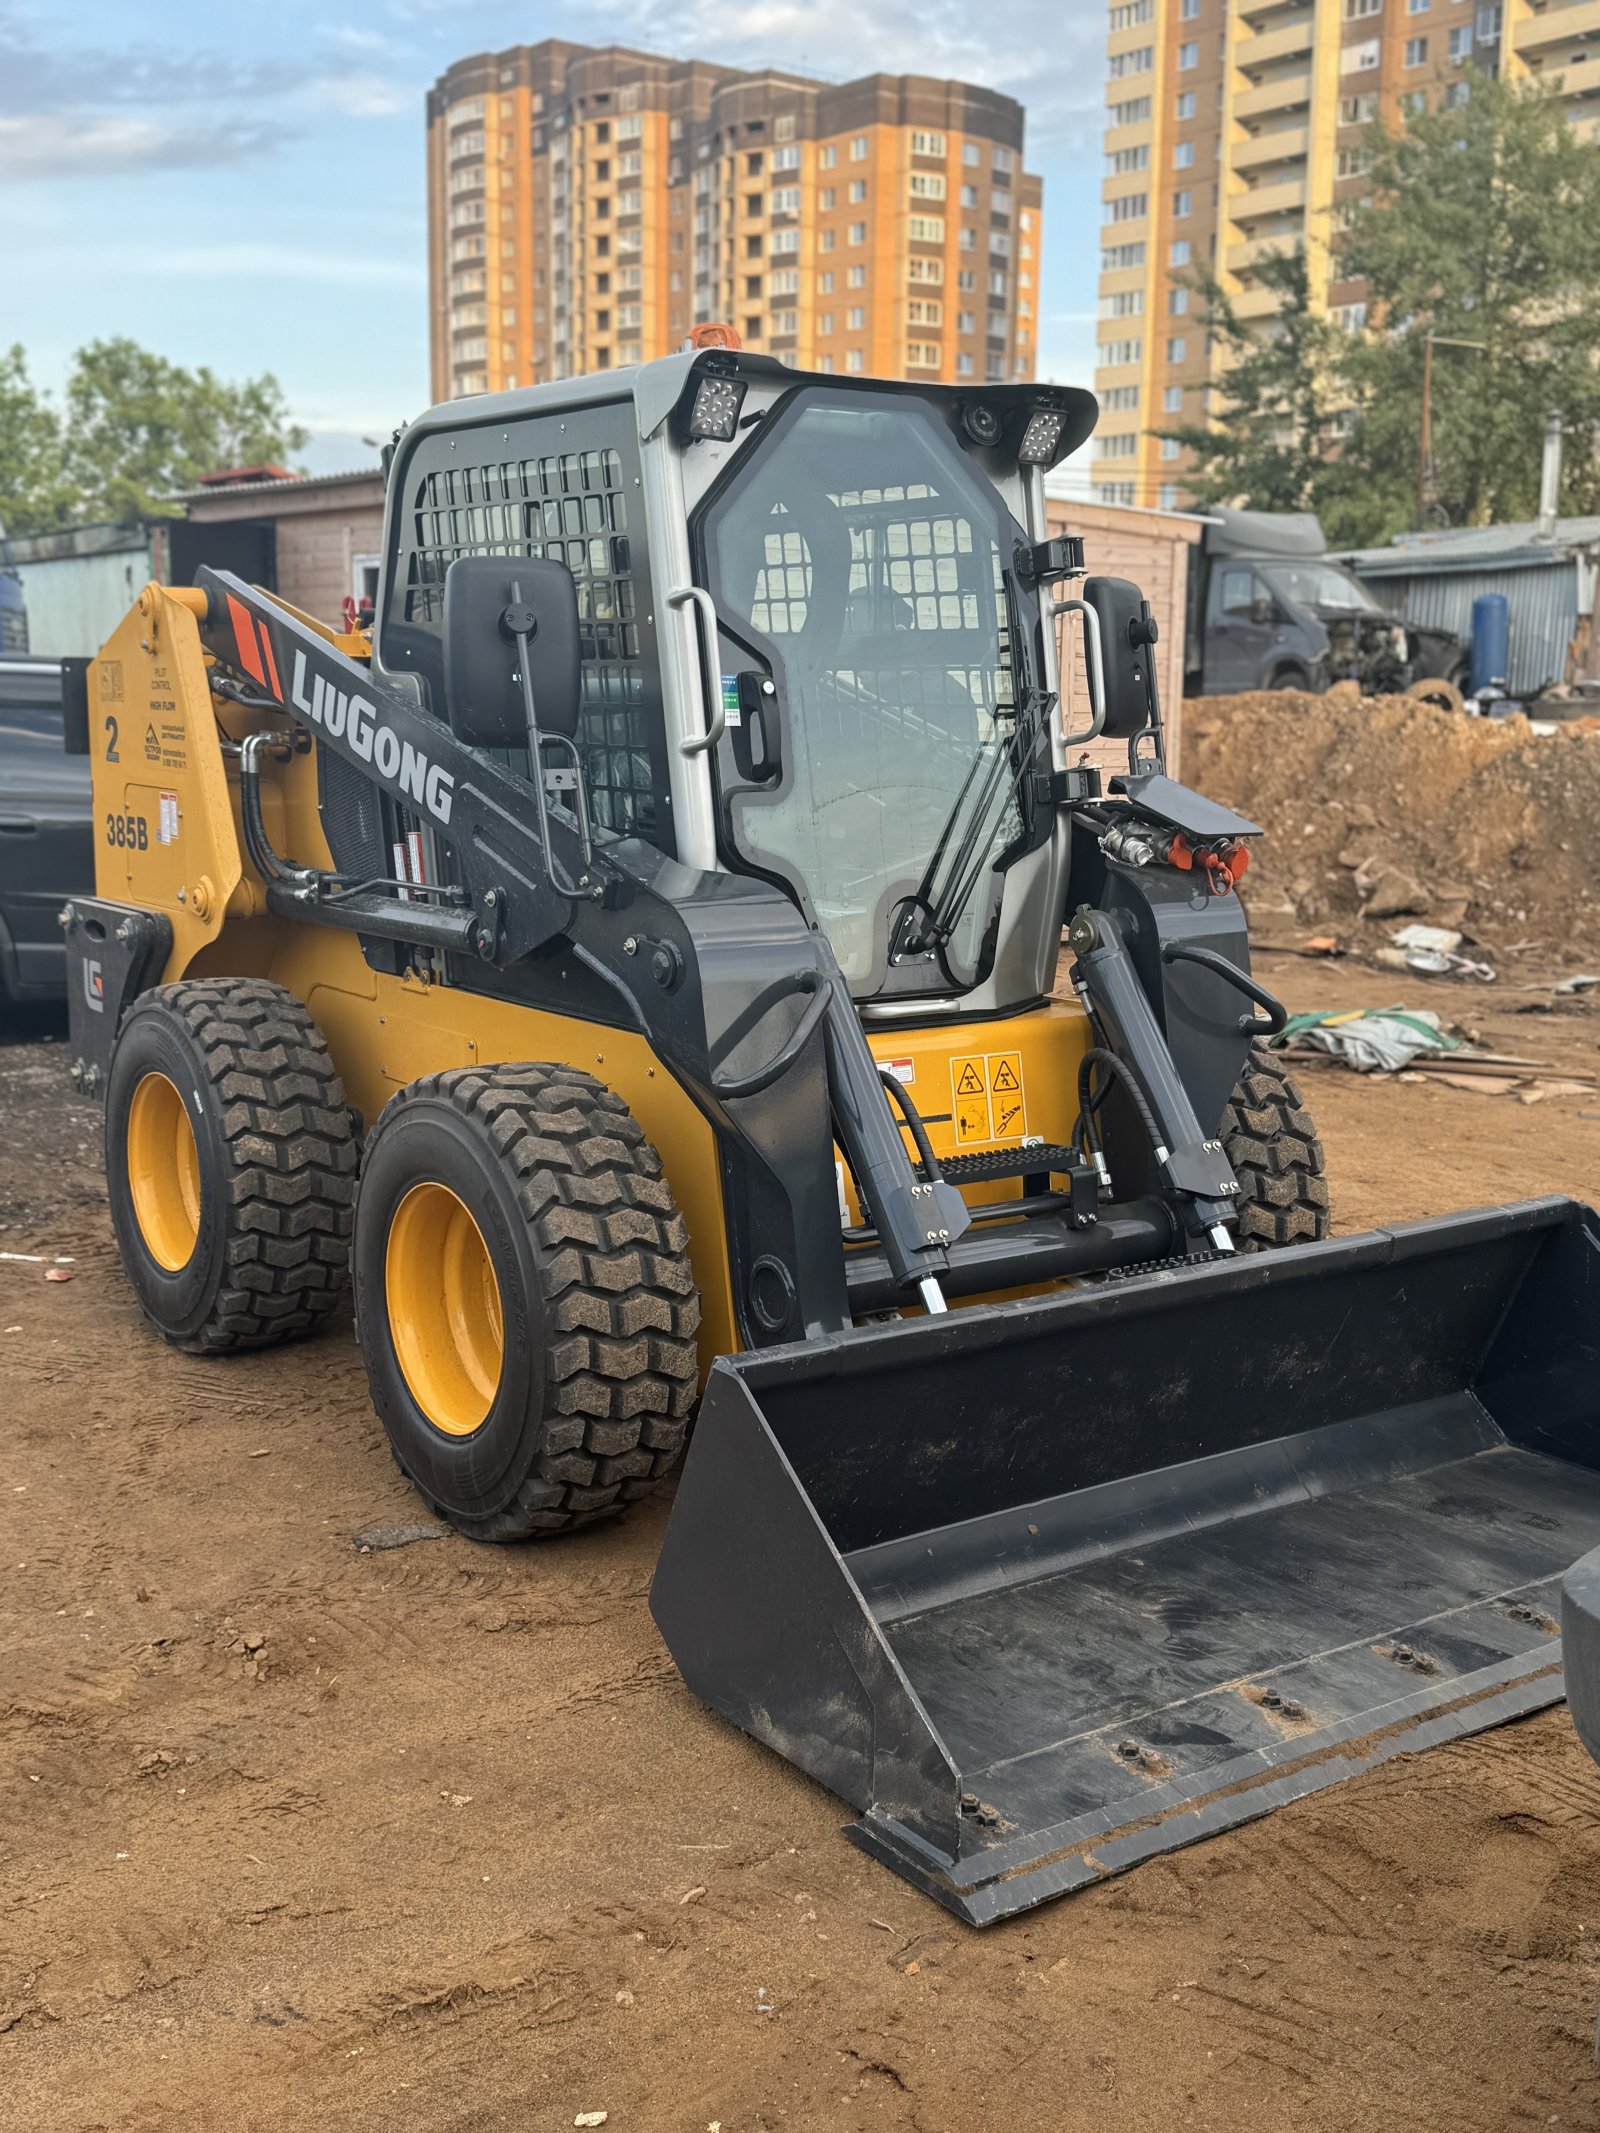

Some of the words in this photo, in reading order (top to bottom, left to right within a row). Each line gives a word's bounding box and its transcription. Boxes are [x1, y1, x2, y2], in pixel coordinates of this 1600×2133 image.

[151, 680, 172, 691] CONTROL
[105, 716, 120, 763] 2
[106, 813, 149, 851] 385B
